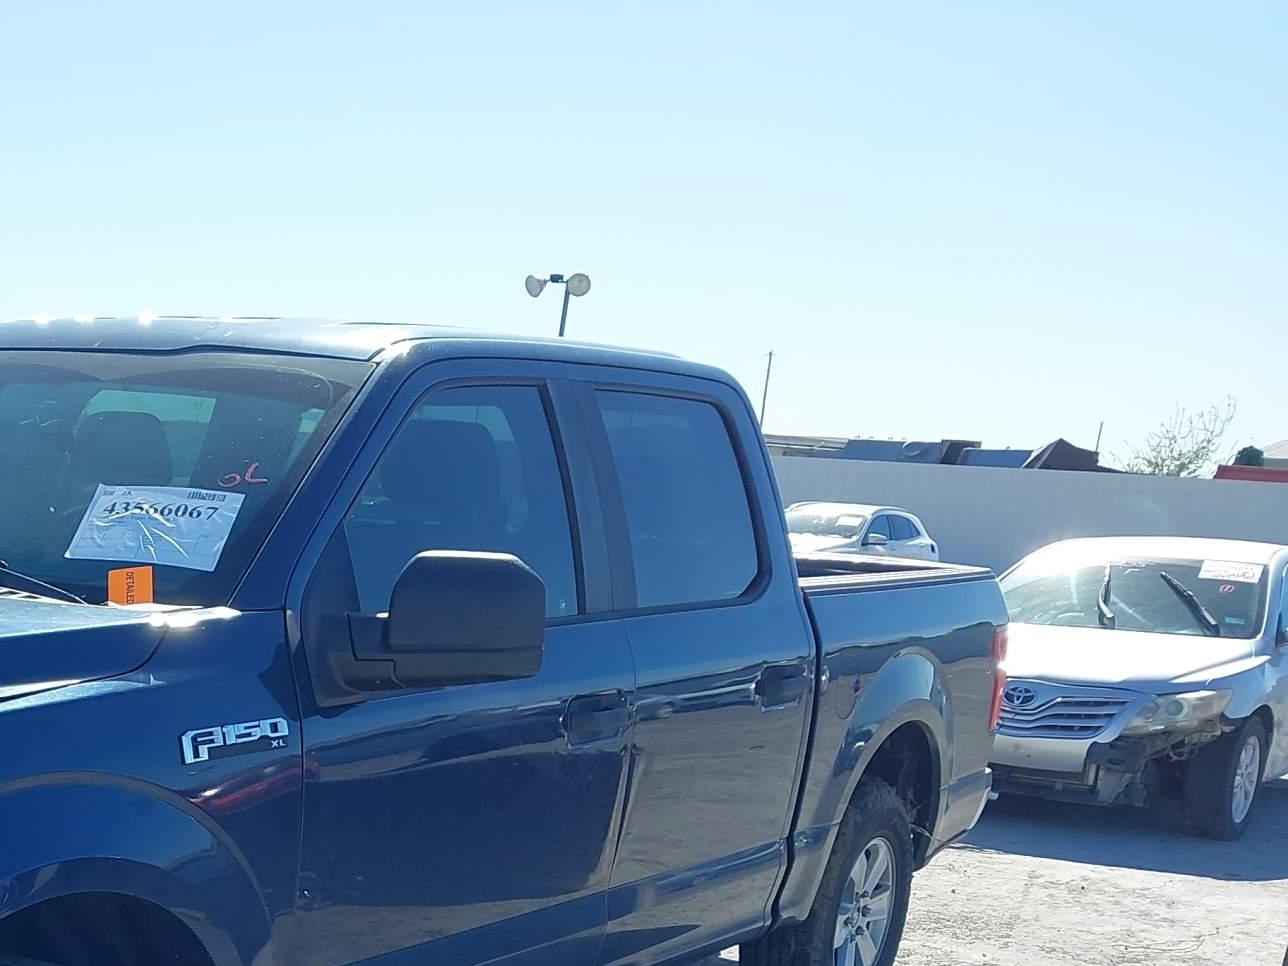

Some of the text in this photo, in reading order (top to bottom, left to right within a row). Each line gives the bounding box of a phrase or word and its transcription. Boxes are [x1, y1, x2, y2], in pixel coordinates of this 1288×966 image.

[103, 501, 220, 521] 43566067
[125, 571, 135, 604] DETAILED
[270, 739, 287, 749] XL
